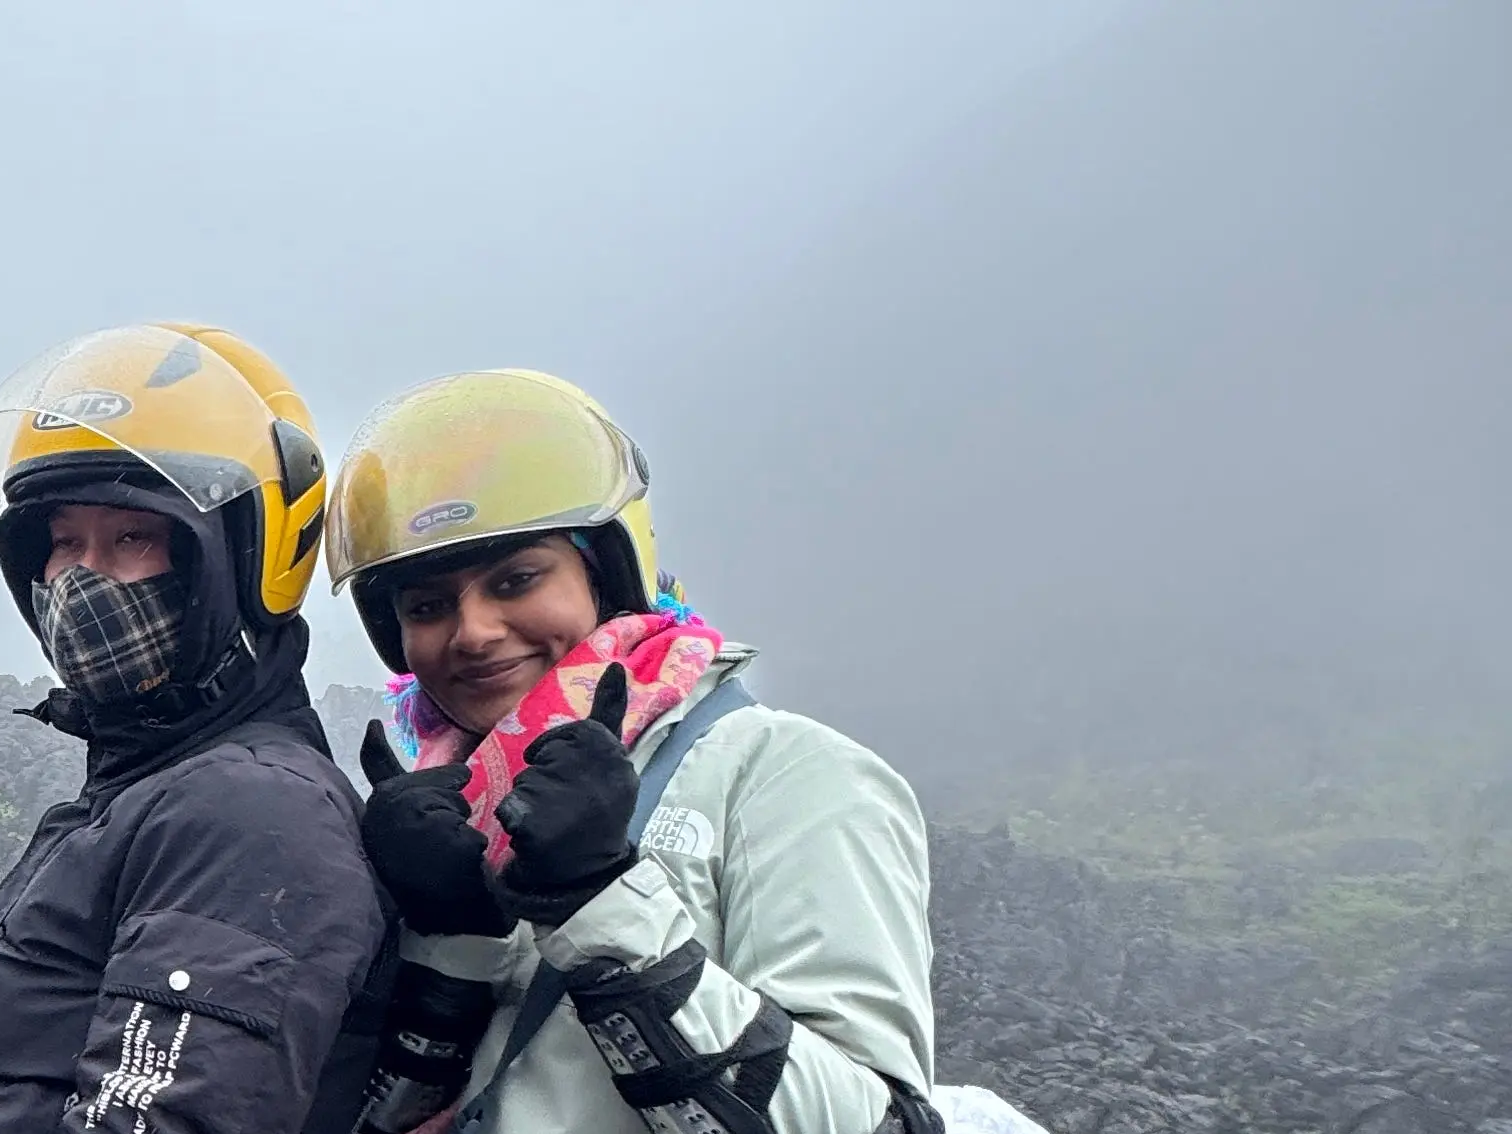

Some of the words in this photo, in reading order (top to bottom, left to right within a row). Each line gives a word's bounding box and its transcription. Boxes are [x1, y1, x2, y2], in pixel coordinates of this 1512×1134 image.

[415, 506, 468, 528] GRO
[653, 806, 689, 822] THE
[645, 820, 681, 836] RTH
[639, 833, 676, 851] ACE
[131, 1019, 153, 1075] FASHION
